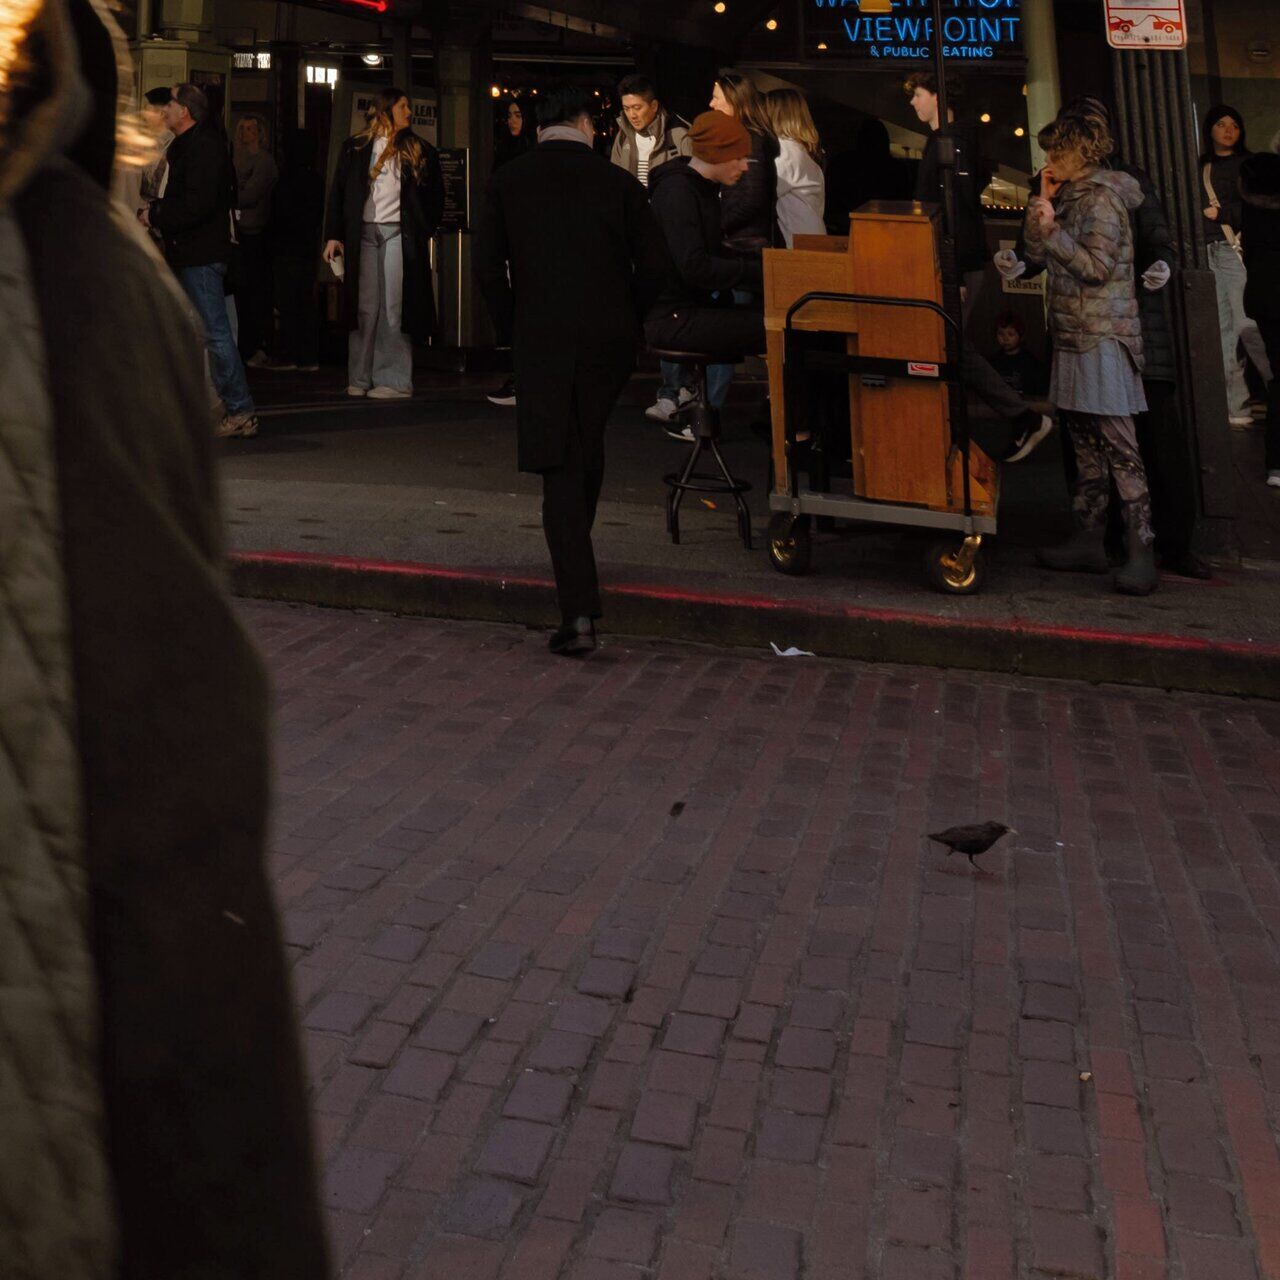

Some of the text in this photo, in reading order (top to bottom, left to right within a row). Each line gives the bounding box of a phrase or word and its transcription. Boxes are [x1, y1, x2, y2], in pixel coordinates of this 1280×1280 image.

[870, 46, 994, 58] & PUBLIC EATING
